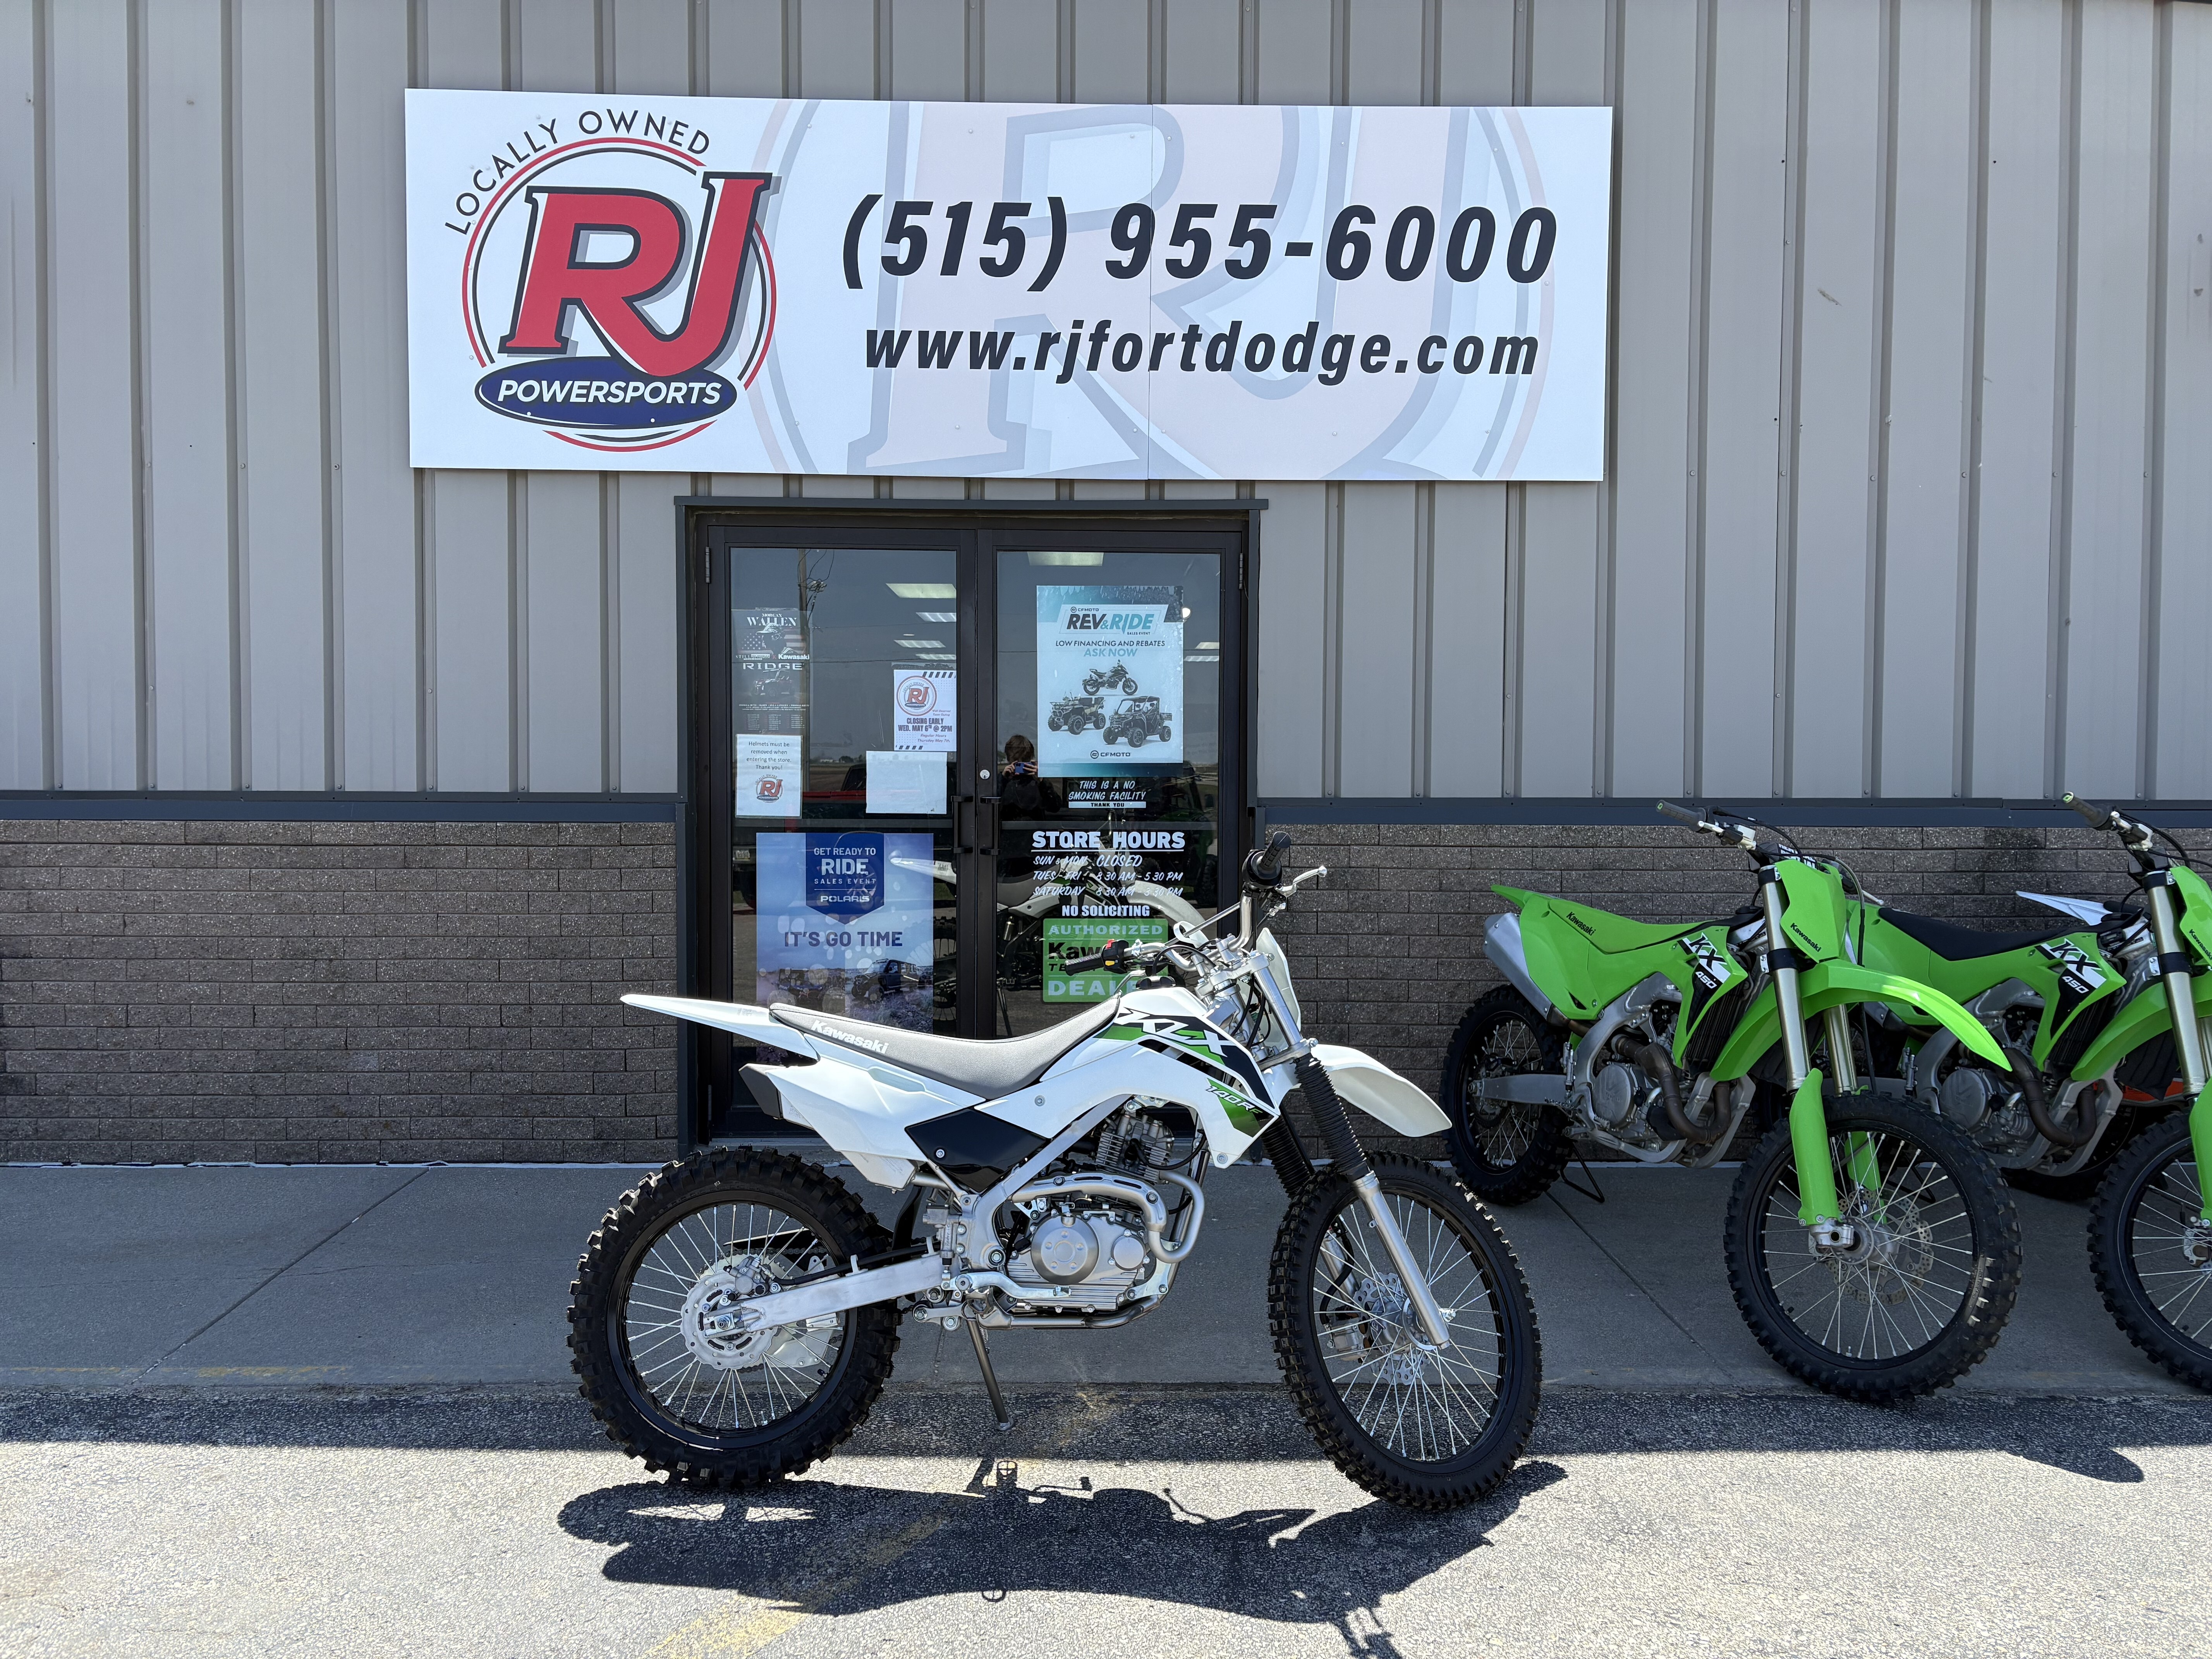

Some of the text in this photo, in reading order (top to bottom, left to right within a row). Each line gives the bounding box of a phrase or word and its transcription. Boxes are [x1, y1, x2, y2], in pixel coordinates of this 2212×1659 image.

[445, 109, 709, 235] LOCALLY OWNED
[842, 194, 1557, 291] (515) 955-6000
[498, 172, 773, 377] RJ
[864, 319, 1539, 386] www.rjfortdodge.com
[498, 380, 722, 405] POWERSPORTS
[1083, 648, 1138, 657] ASK NOW
[907, 687, 929, 704] RJ
[759, 779, 783, 797] RJ
[1080, 780, 1135, 789] THIS IS A NO
[1068, 792, 1146, 800] SMOKING FACILITY
[1032, 831, 1185, 848] STORE HOURS
[821, 859, 869, 875] RIDE
[1033, 855, 1055, 865] SUN
[1063, 855, 1088, 865] MON
[1096, 855, 1142, 867] CLOSED
[1033, 871, 1056, 881] TUES
[1065, 871, 1082, 880] FRI
[1118, 871, 1136, 881] AM
[1166, 872, 1183, 881] PM
[1033, 886, 1085, 896] SATURDAY
[1118, 887, 1135, 896] AM
[1166, 887, 1183, 896] PM
[1062, 905, 1150, 917] NO SOLICITING
[1048, 925, 1163, 935] AUTHORIZED
[1566, 911, 1596, 936] Kawasaki
[785, 931, 903, 947] IT'S GO TIME
[1790, 922, 1822, 953] Kawasaki
[2189, 929, 2212, 960] Kawasak
[1688, 932, 1728, 972] KX
[2049, 938, 2102, 977] KX
[1048, 980, 1137, 996] DEAL
[1695, 971, 1717, 989] 450
[2062, 976, 2089, 994] 450
[811, 1019, 889, 1054] Kawasaki
